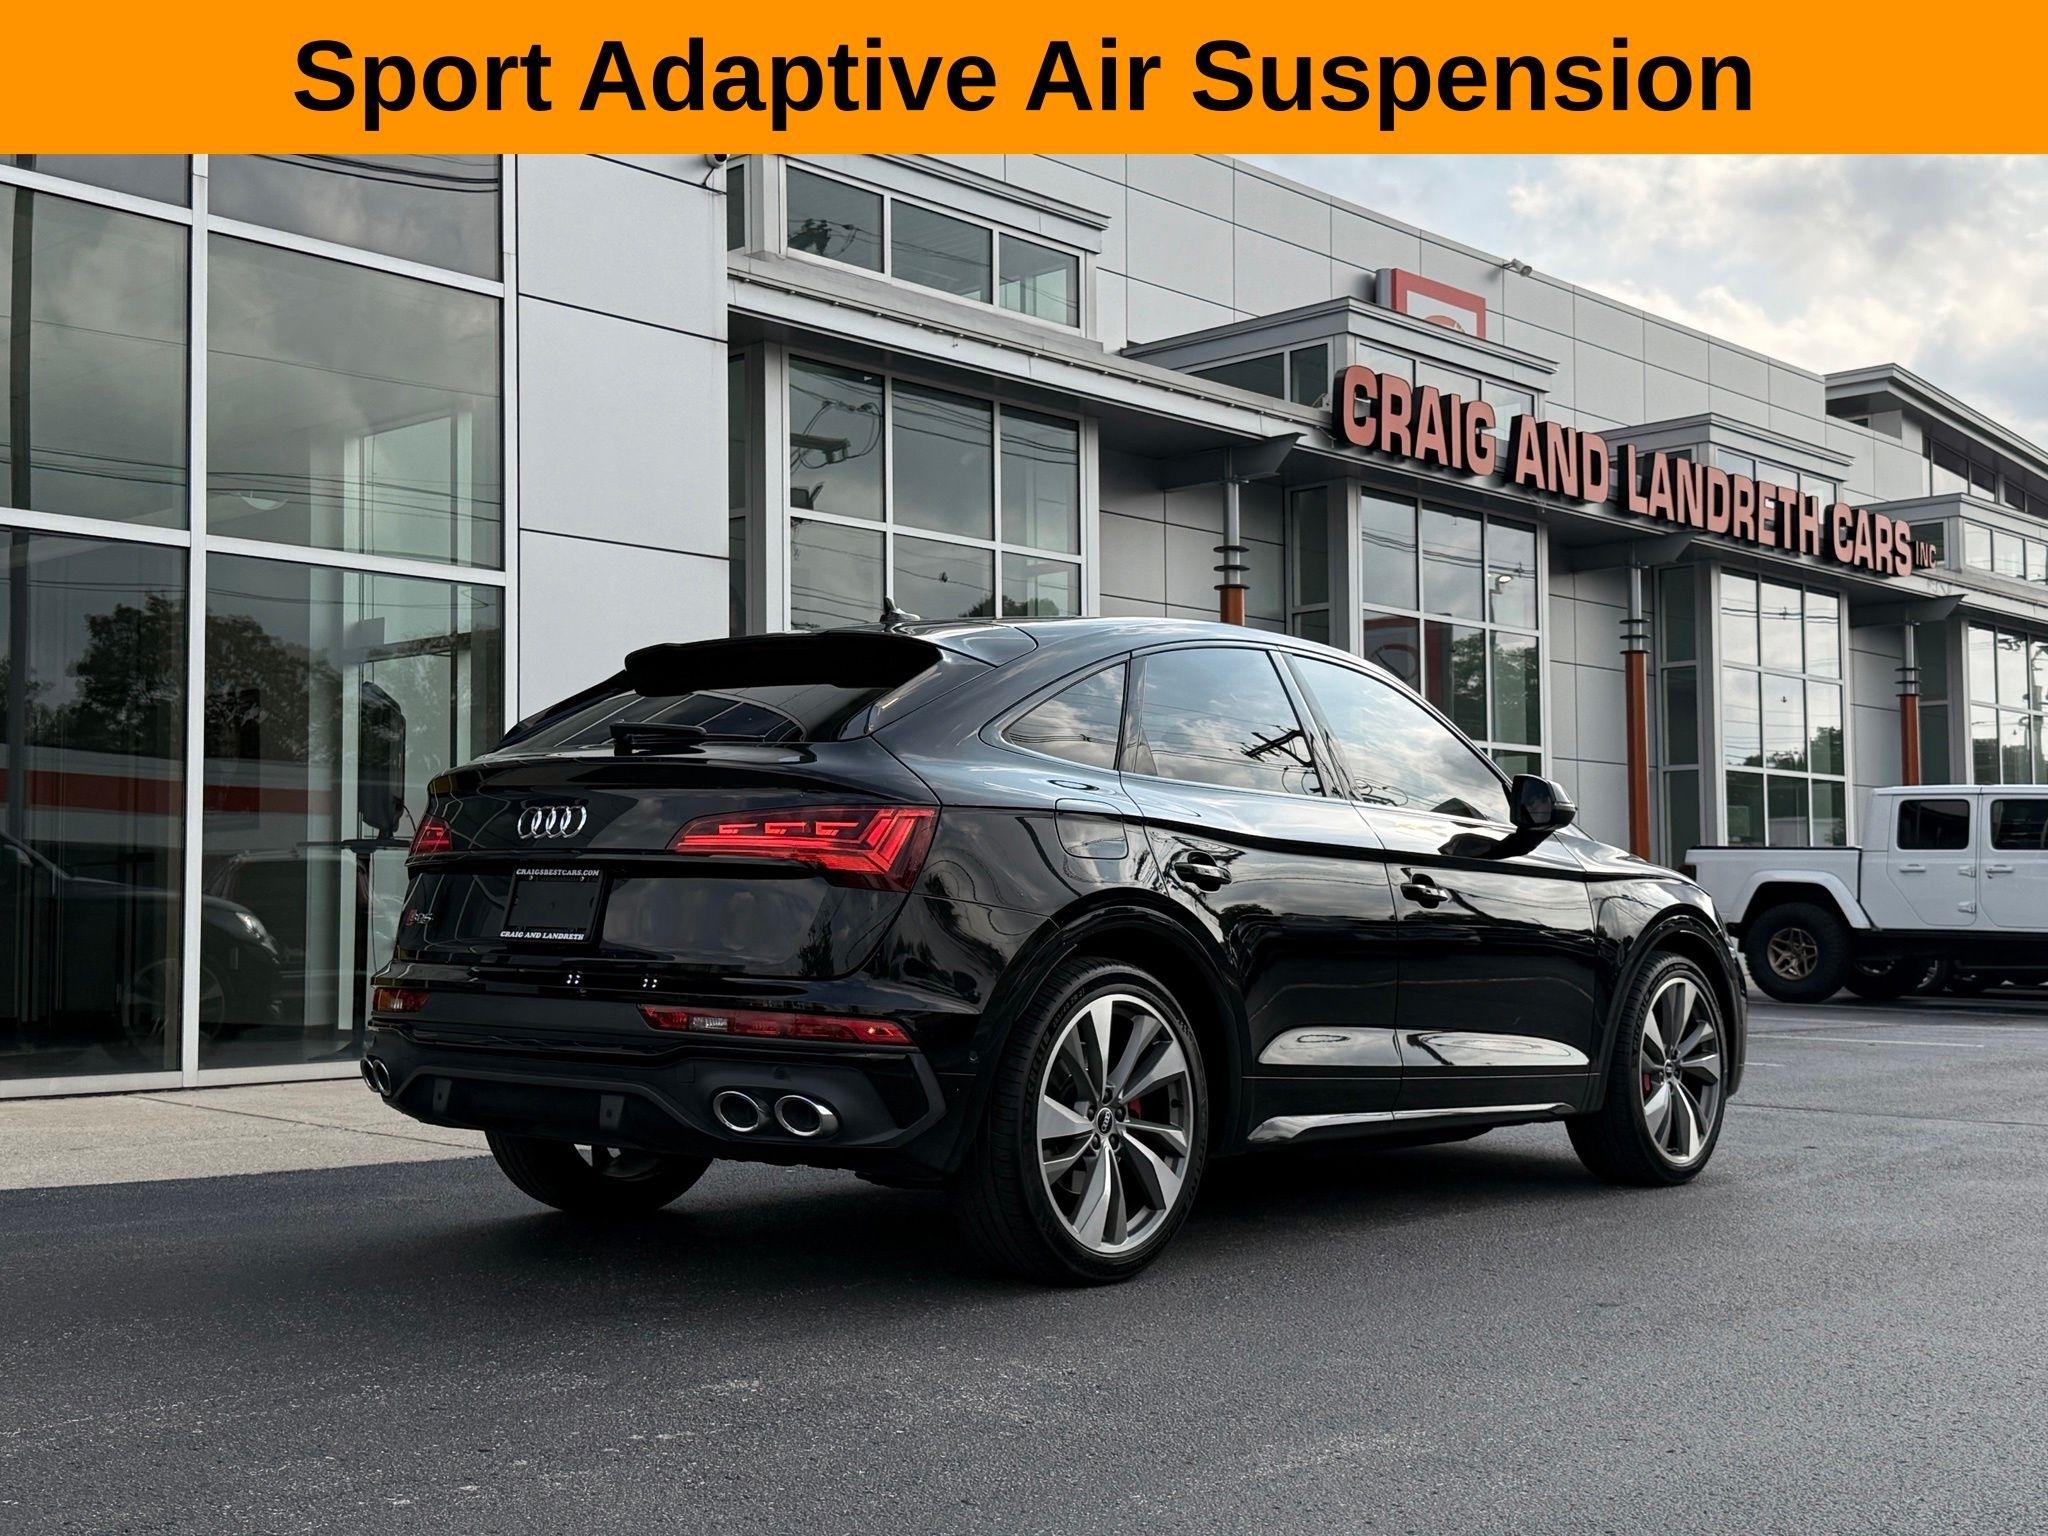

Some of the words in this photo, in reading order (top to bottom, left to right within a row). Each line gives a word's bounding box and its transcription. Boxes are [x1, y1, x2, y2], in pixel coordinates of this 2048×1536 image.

[1341, 365, 1496, 476] CRAIG
[1513, 414, 1609, 503] AND
[1626, 444, 1820, 556] LANDRETH
[1831, 503, 1912, 577] CARS
[1915, 540, 1937, 569] INC
[516, 868, 600, 877] CRAIGSBESTCARS.COM
[500, 930, 524, 938] CRAIG
[524, 931, 541, 939] AND
[542, 931, 584, 940] LANDRETH
